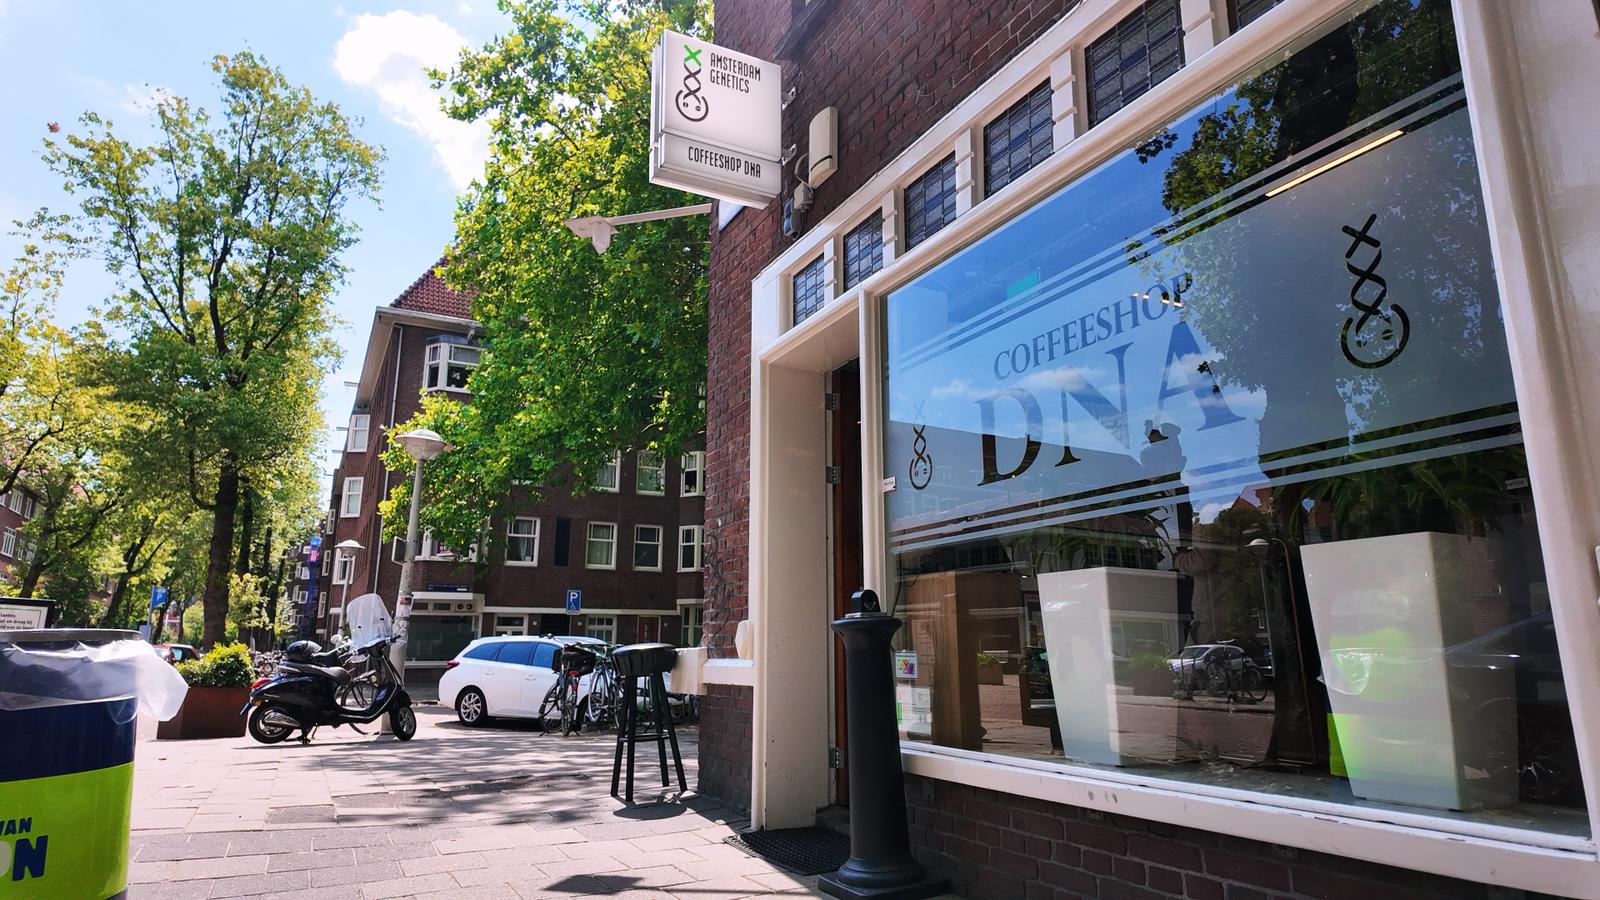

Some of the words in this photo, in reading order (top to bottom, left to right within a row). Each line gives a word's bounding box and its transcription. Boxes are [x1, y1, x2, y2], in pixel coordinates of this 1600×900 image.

[710, 53, 761, 82] AMSTERDAM
[710, 69, 750, 94] GENETICS
[688, 146, 742, 173] COFFEESHOP
[744, 163, 761, 178] DNA
[993, 272, 1193, 380] COFFEESHOP
[973, 320, 1247, 487] DNA
